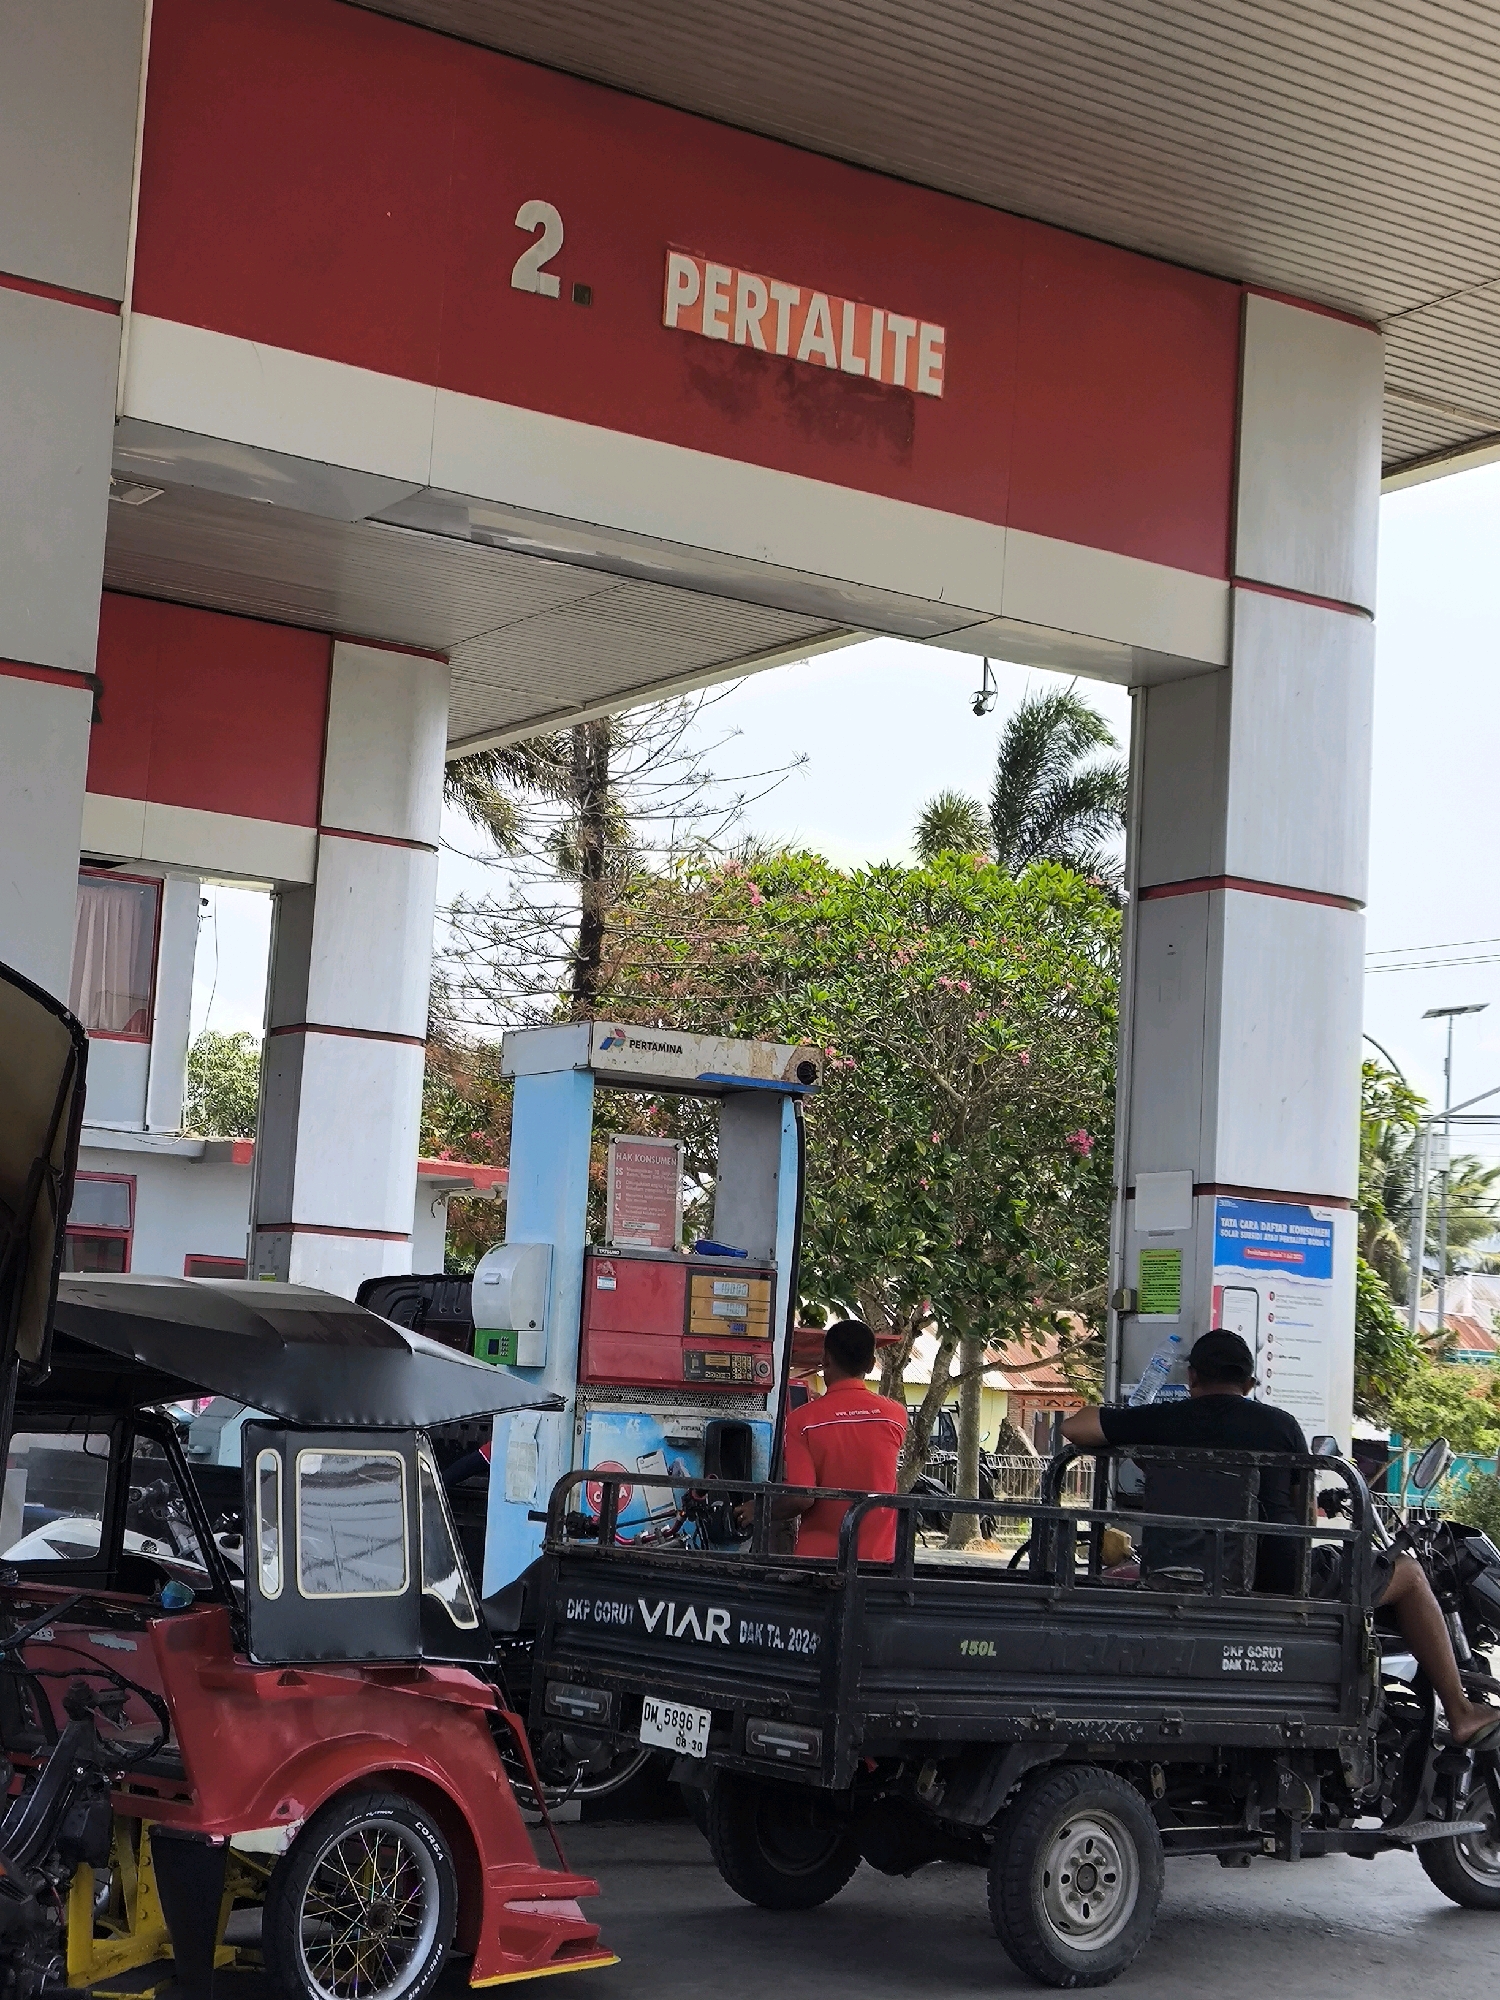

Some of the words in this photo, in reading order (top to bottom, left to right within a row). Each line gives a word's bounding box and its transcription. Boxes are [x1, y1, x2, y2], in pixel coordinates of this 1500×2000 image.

[664, 250, 945, 397] PERTALITE
[629, 1039, 683, 1054] PERTAMINA
[616, 1152, 633, 1162] HAK
[634, 1154, 677, 1166] KONSUMEN
[1220, 1217, 1238, 1228] TATA
[1239, 1219, 1259, 1231] CARA
[1260, 1221, 1288, 1234] DAFTAR
[1289, 1224, 1331, 1238] KONSUMEN
[1220, 1229, 1239, 1238] SOLAR
[566, 1598, 591, 1621] DKP
[594, 1599, 634, 1625] GORUT
[637, 1597, 731, 1645] VIAR
[960, 1639, 997, 1657] 150L
[1247, 1645, 1283, 1659] GORUT
[1261, 1660, 1284, 1673] 2024
[644, 1702, 659, 1724] DM
[664, 1707, 694, 1731] 5896
[698, 1715, 707, 1734] F
[414, 1821, 444, 1861] CORSA
